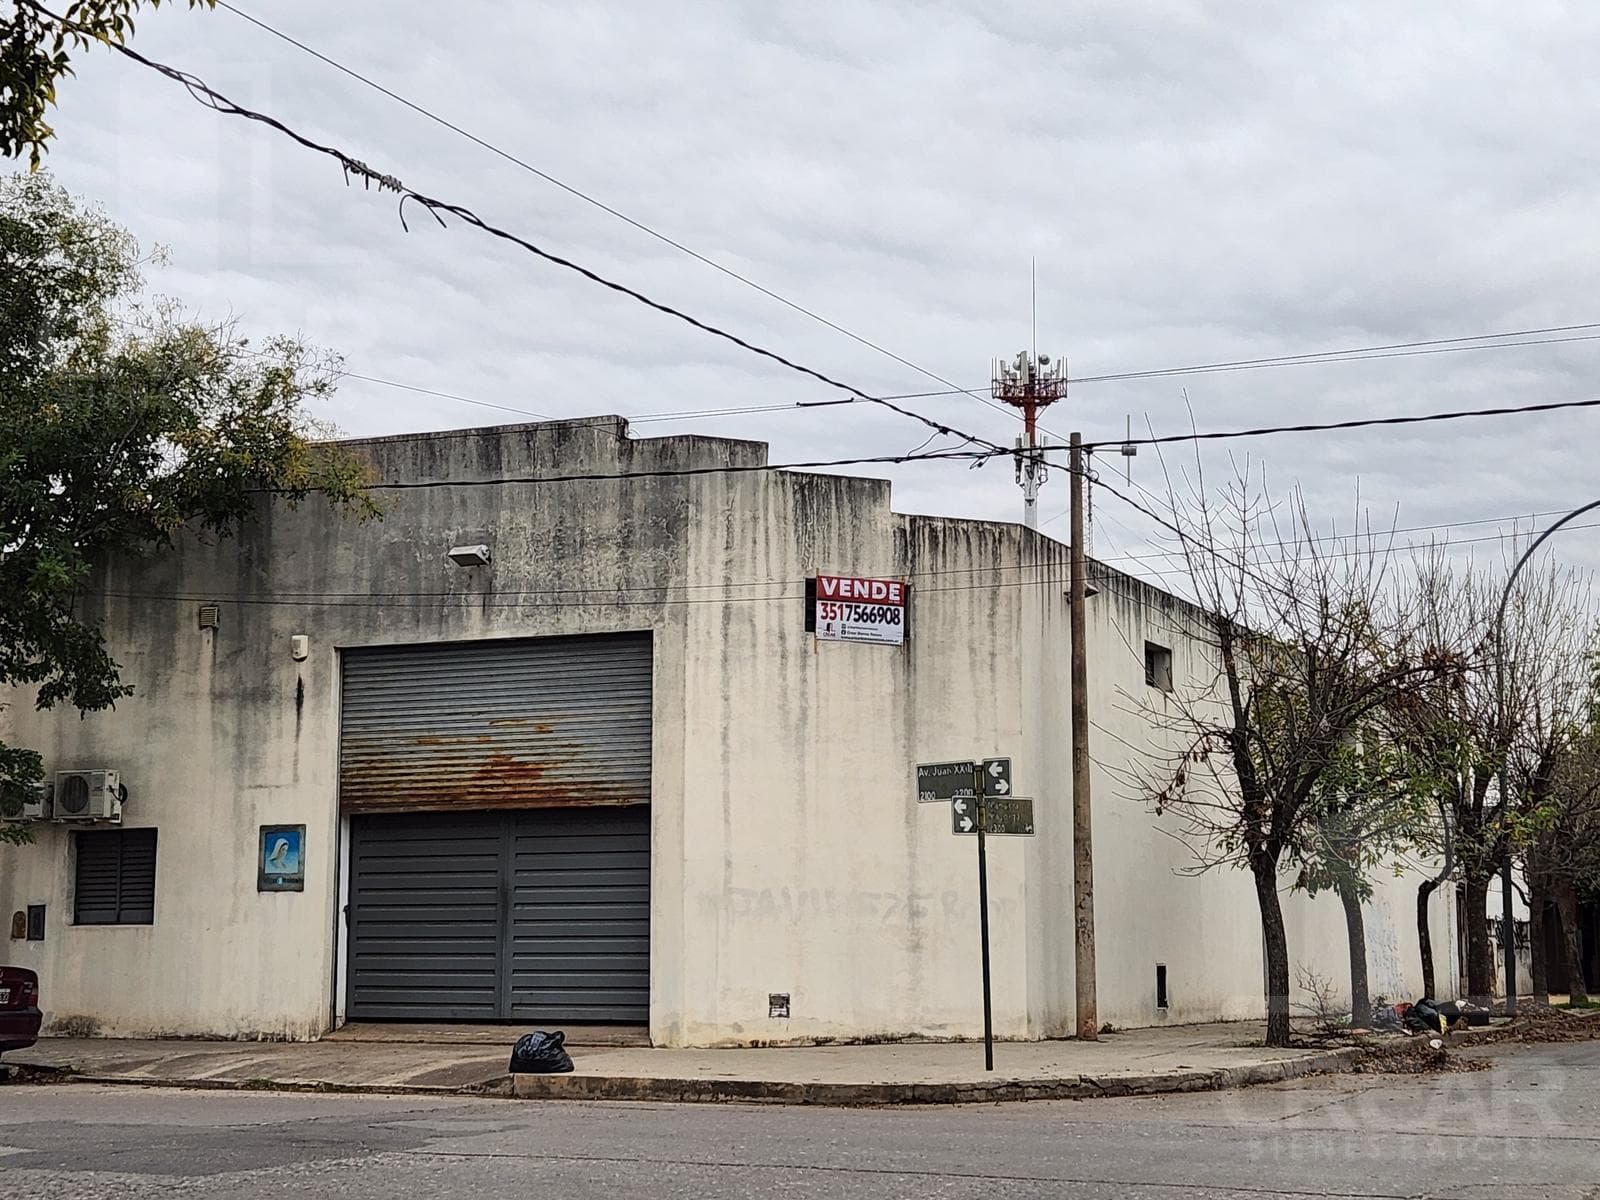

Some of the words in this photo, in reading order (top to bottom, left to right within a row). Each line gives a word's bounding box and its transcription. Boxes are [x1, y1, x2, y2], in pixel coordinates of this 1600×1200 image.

[821, 577, 900, 600] VENDE
[820, 602, 900, 625] 3517566908
[932, 766, 951, 776] Juan
[920, 791, 936, 801] 2100
